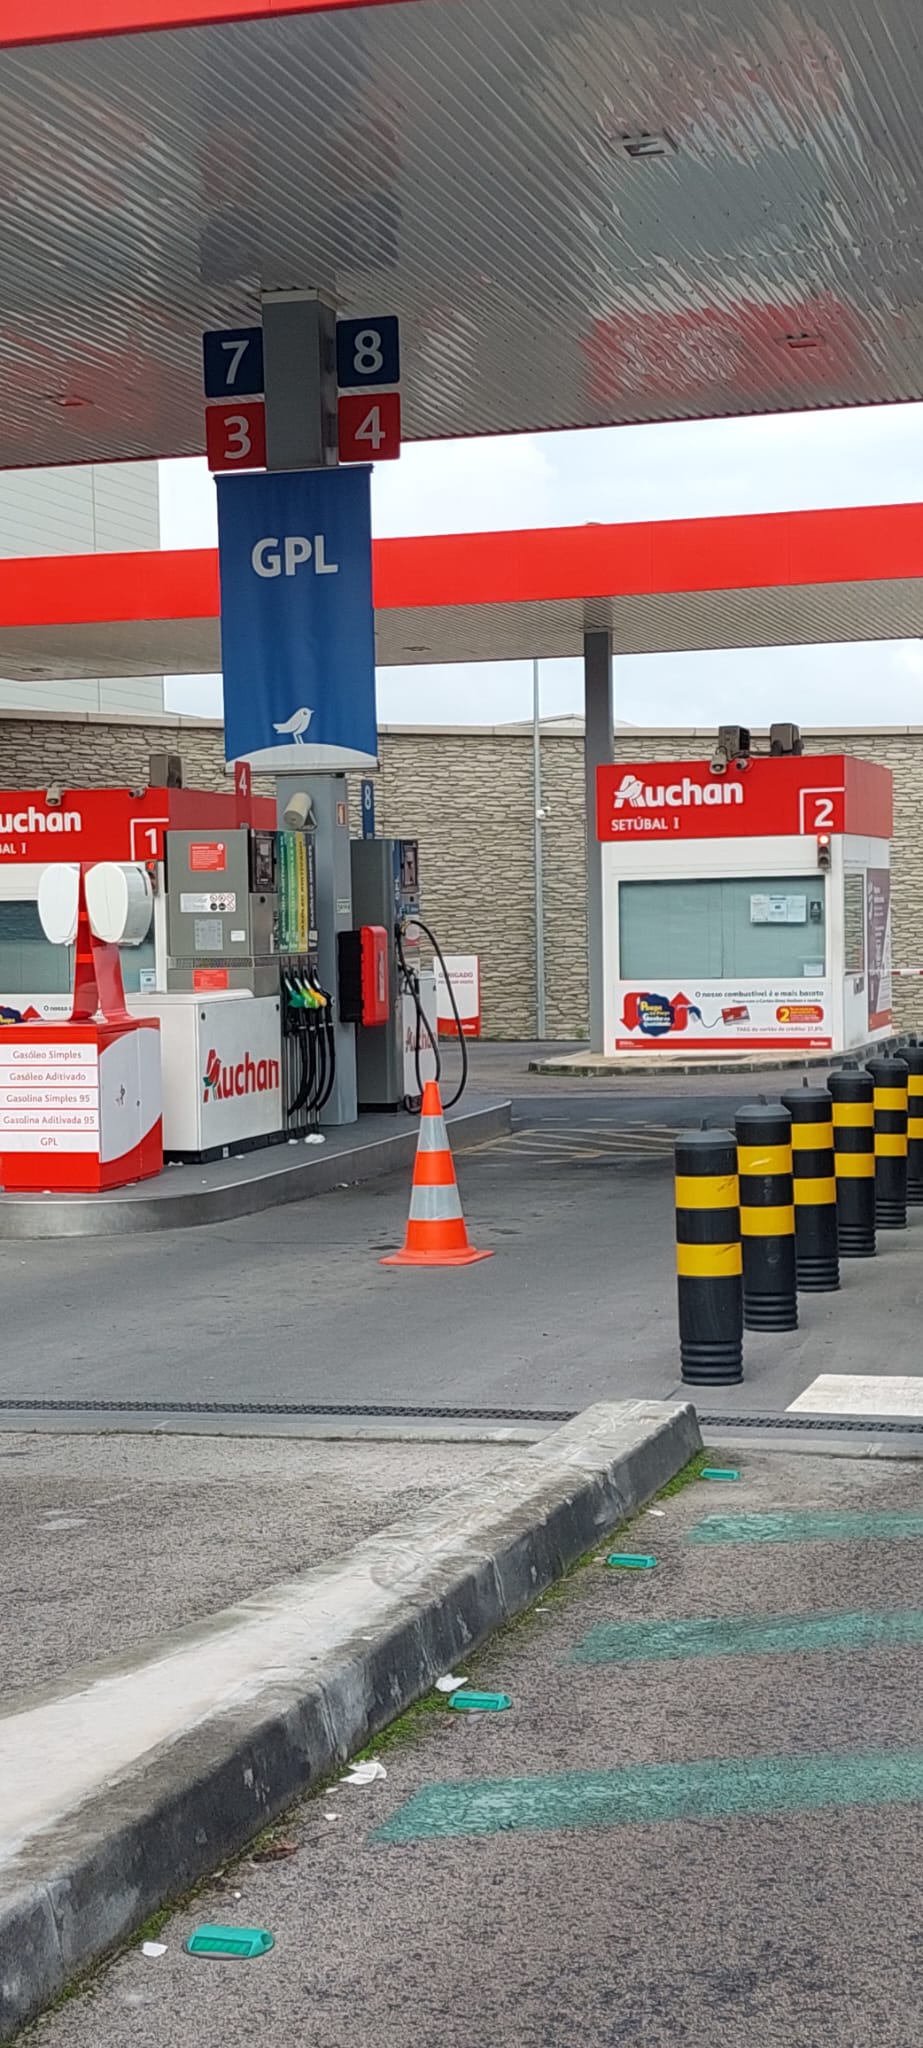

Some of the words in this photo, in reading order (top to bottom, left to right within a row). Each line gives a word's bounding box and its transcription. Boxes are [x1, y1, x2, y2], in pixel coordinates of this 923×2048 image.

[221, 340, 249, 385] 7
[353, 329, 384, 374] 8
[223, 415, 251, 459] 3
[355, 406, 386, 449] 4
[251, 535, 339, 577] GPL
[239, 768, 247, 796] 4
[613, 775, 744, 808] Auchan
[364, 785, 372, 810] 8
[611, 815, 668, 831] SETÚBAL
[673, 816, 680, 829] I
[814, 798, 834, 827] 2
[145, 828, 157, 855] 1
[780, 1008, 790, 1022] 2
[12, 1050, 47, 1059] Gasóleo
[49, 1050, 82, 1060] Simples
[9, 1072, 44, 1081] Gasóleo
[45, 1072, 86, 1081] Aditivado
[203, 1049, 279, 1103] Auchan
[6, 1094, 43, 1103] Gasolina
[44, 1094, 77, 1104] Simples
[79, 1094, 90, 1103] 95
[3, 1116, 39, 1124] Gasolina
[42, 1116, 81, 1124] Aditivada
[84, 1116, 95, 1124] 95
[40, 1137, 58, 1146] GPL
